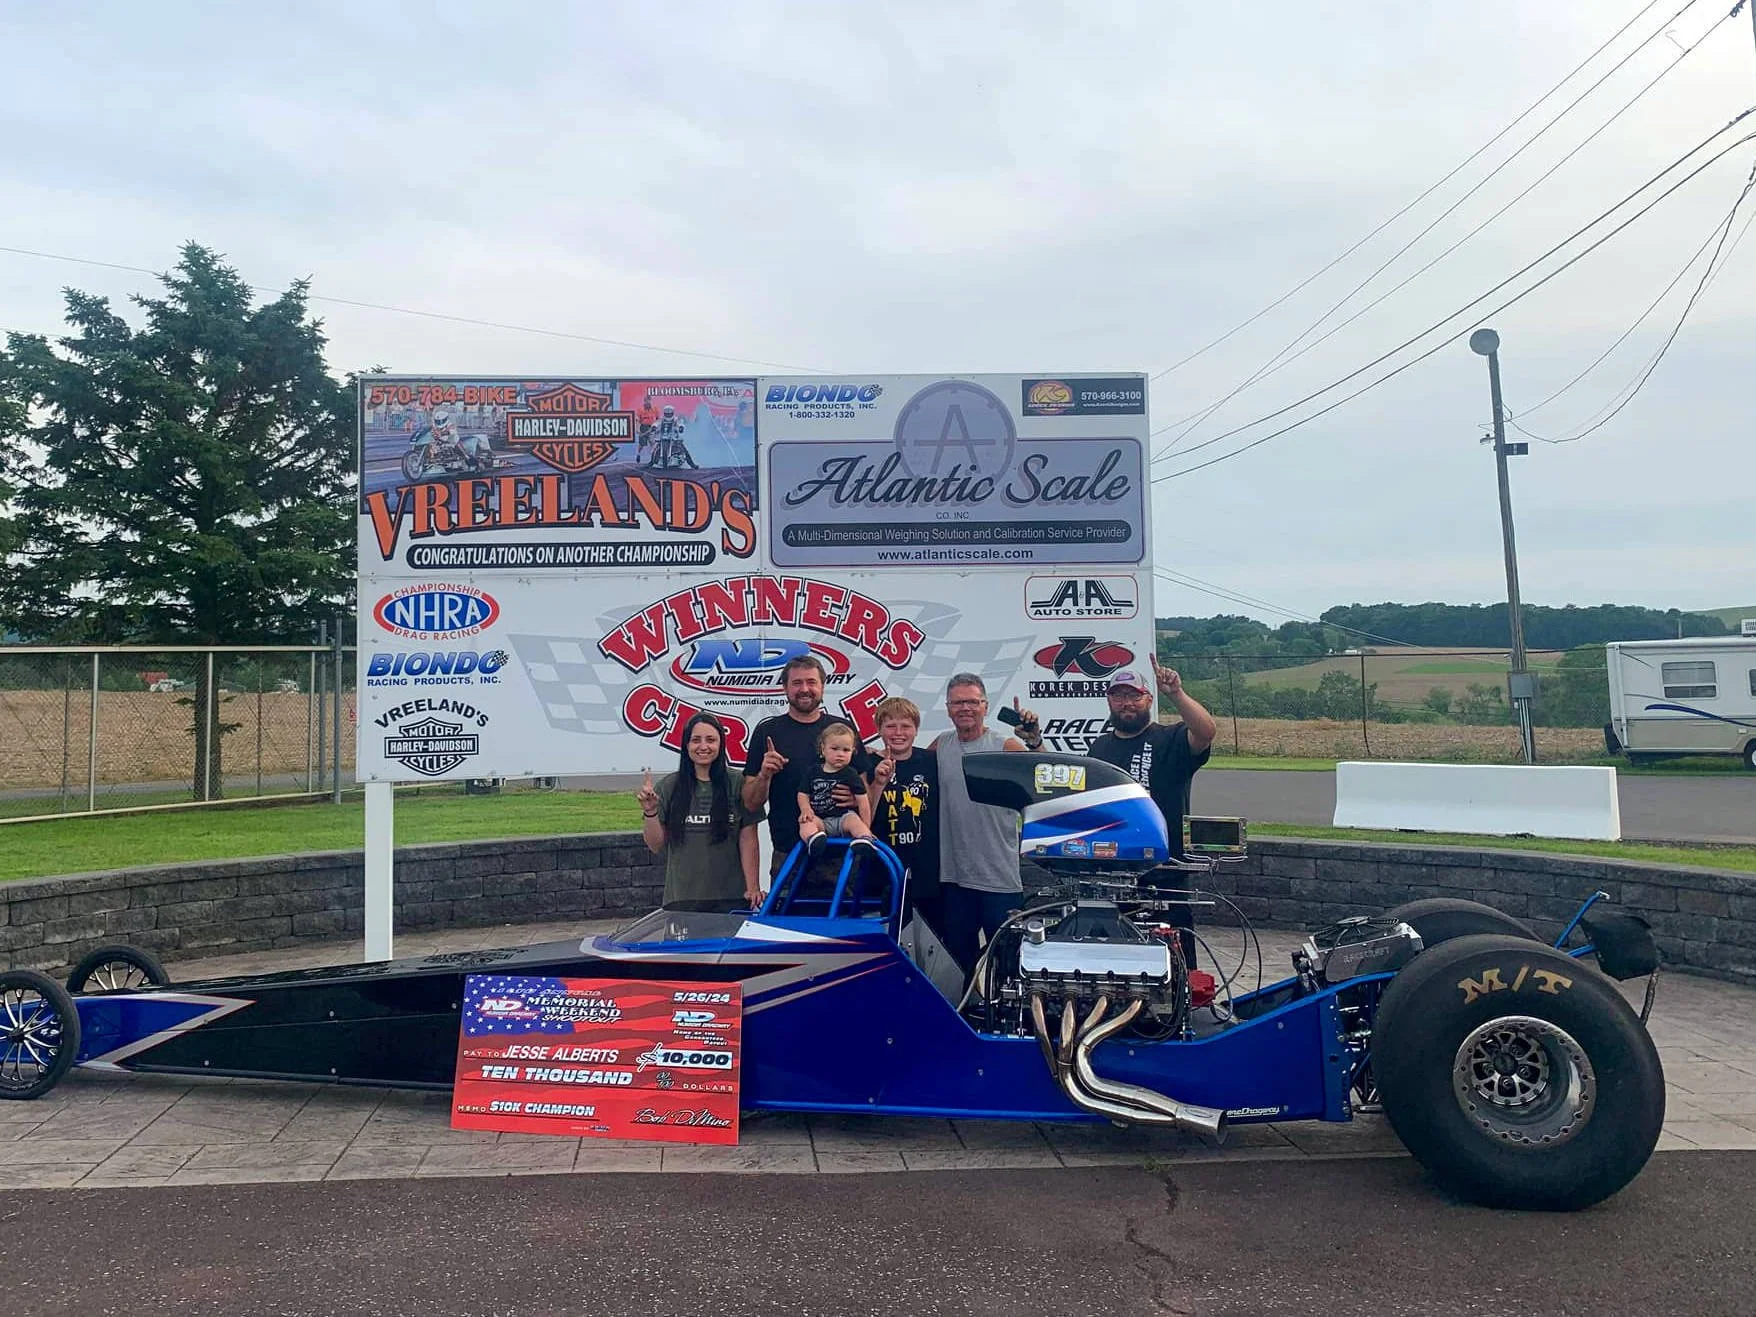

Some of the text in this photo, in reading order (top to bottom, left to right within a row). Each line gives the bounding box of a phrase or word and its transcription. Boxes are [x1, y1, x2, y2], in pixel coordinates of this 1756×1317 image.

[370, 385, 518, 406] 570-784-BIKE
[765, 384, 881, 402] BIONDO
[541, 391, 600, 412] MOTOR
[789, 411, 855, 419] 1-800-332-1320
[515, 417, 628, 438] HARLEY-DAVIDSON
[543, 443, 603, 468] CYCLES
[785, 449, 1131, 504] Atlantic Scale
[366, 473, 757, 560] VREELAND'S
[787, 526, 1126, 542] A Multi-Dimensional Weighing Solution and Calibration Service Provider
[413, 544, 710, 565] CONGRATULATIONS ON ANOTHER CHAMPIONSHIP
[878, 549, 1033, 560] www.atlanticscale.com
[394, 583, 481, 599] CHAMPIONSHIP
[394, 594, 482, 630] NHRA
[1076, 608, 1122, 616] STORE
[598, 575, 926, 674] WINNERS
[394, 627, 480, 641] DRAG RACING
[367, 651, 506, 677] BIONDO
[684, 639, 812, 675] ND
[367, 676, 502, 687] RACING PRODUCTS, INC.
[706, 674, 775, 686] NUMIDIA
[1030, 682, 1108, 692] KOREK DES
[704, 699, 789, 707] www.numidiadrag
[374, 698, 489, 729] VREELAND'S
[409, 724, 456, 737] MOTOR
[390, 739, 473, 753] HARLEY-DAVIDSON
[410, 756, 456, 772] CYCLES
[1035, 763, 1086, 787] 397
[883, 790, 898, 846] WATT
[898, 832, 914, 845] 90
[1457, 964, 1573, 1004] M/T
[480, 999, 522, 1011] ND
[527, 996, 617, 1008] MEMORIAL
[673, 991, 731, 1003] 5/26/24
[542, 1014, 622, 1024] SHOOTOUT
[545, 1006, 622, 1018] WEEKEND
[671, 1010, 716, 1023] ND
[502, 1045, 550, 1060] JESSE
[552, 1047, 619, 1063] ALBERTS
[481, 1065, 633, 1086] TEN THOUSAND
[683, 1083, 734, 1092] DOLLARS
[457, 1105, 486, 1113] MEMO
[524, 1102, 595, 1117] CHAMPION
